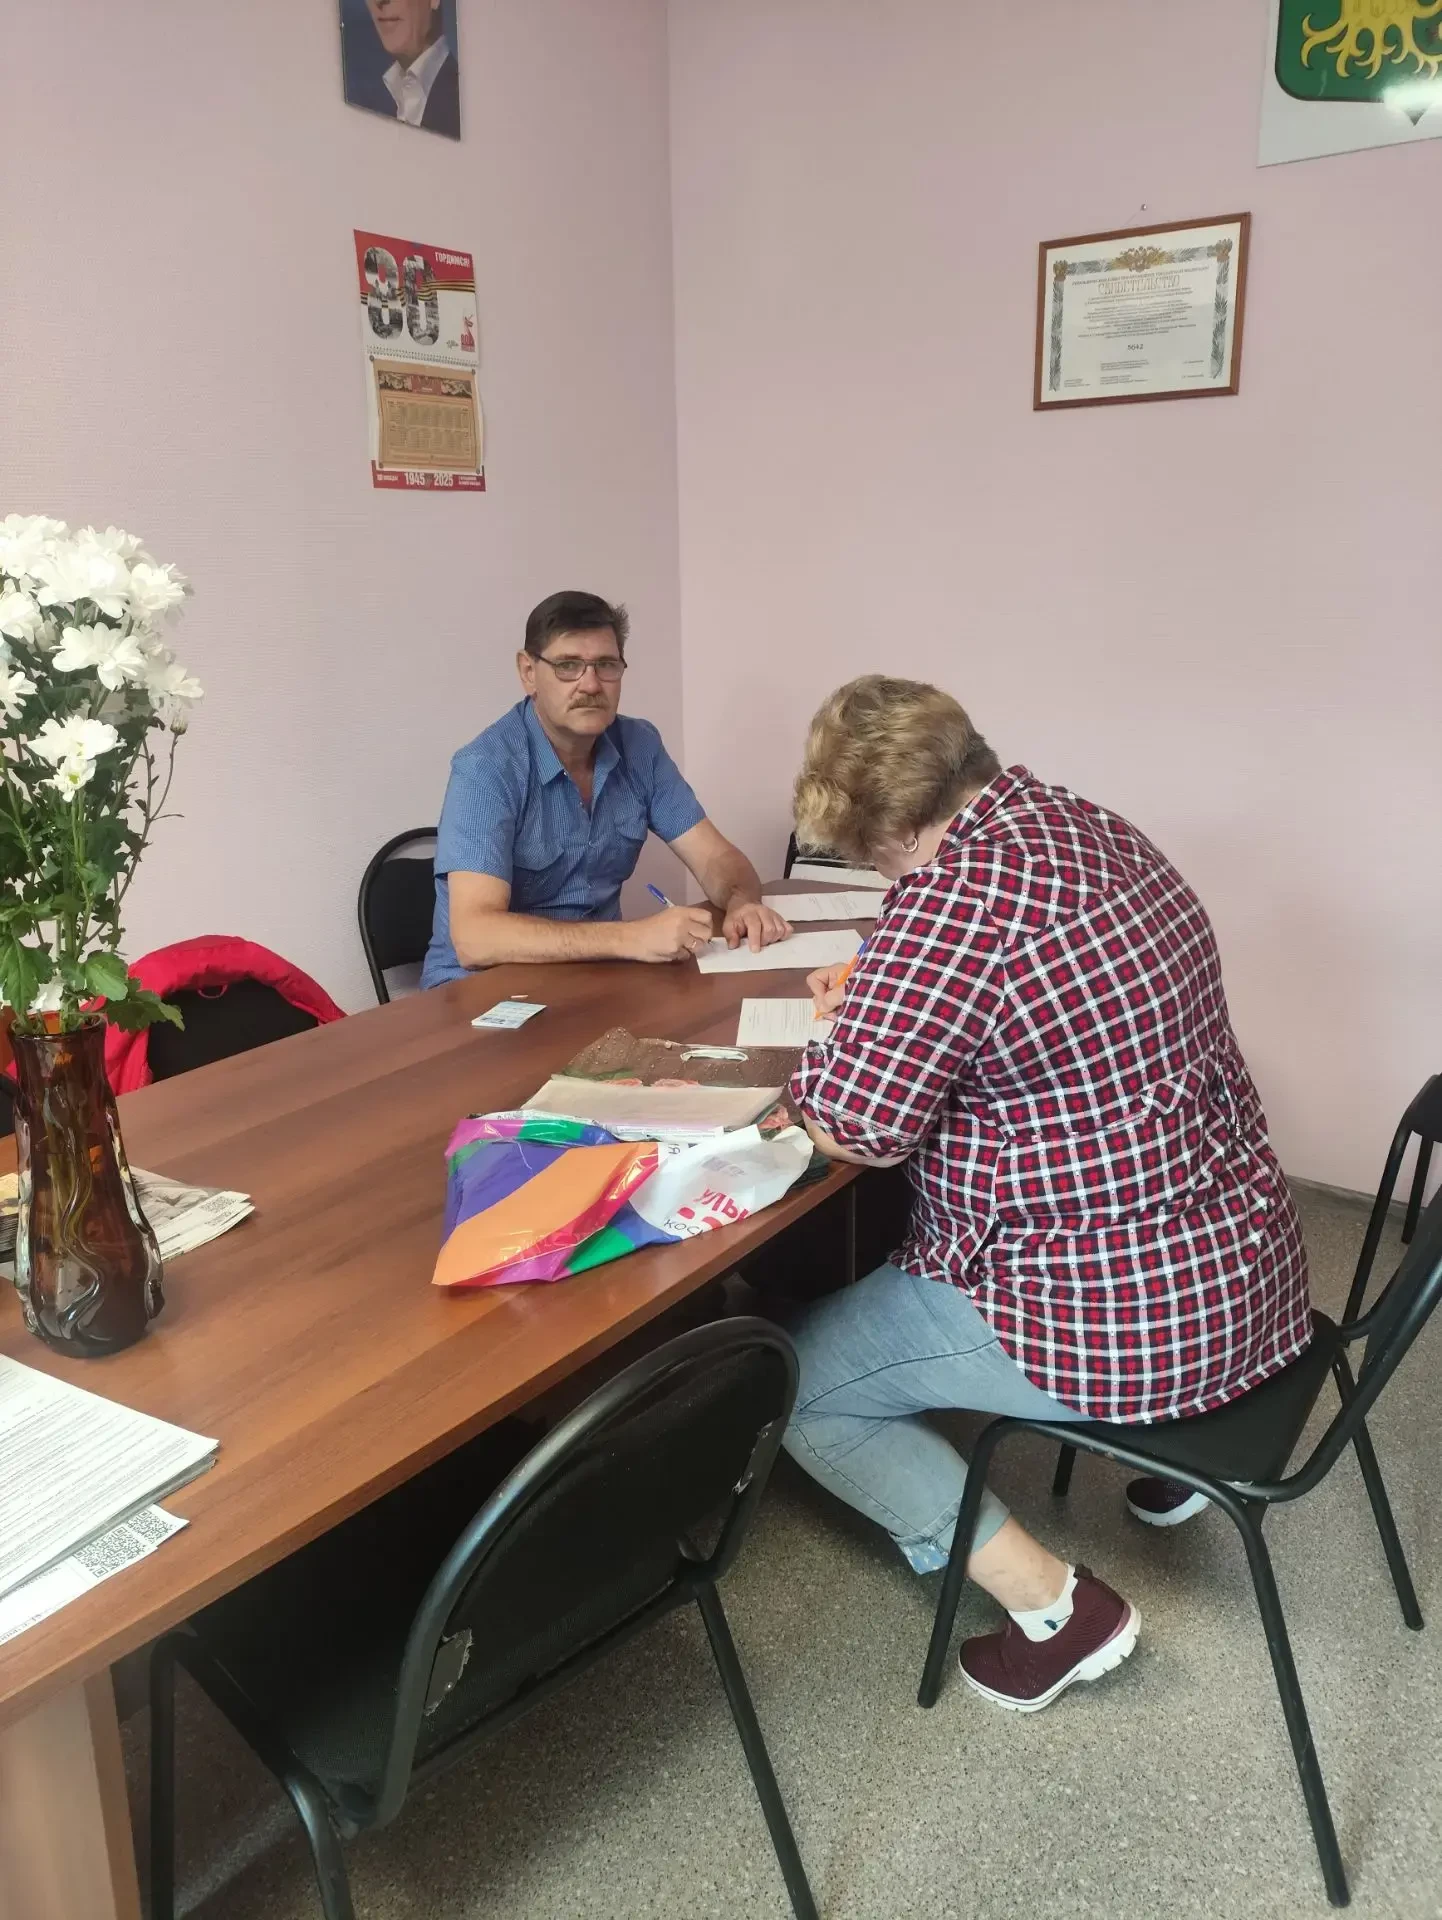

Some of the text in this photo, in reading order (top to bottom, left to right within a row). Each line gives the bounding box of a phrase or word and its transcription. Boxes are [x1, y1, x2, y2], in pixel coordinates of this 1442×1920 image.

[434, 251, 471, 268] ГОРДИМСЯ!
[1098, 275, 1181, 296] СВИДЕТЕЛЬСТВО
[363, 247, 440, 346] 80
[404, 472, 426, 486] 1945
[433, 473, 454, 487] 2025
